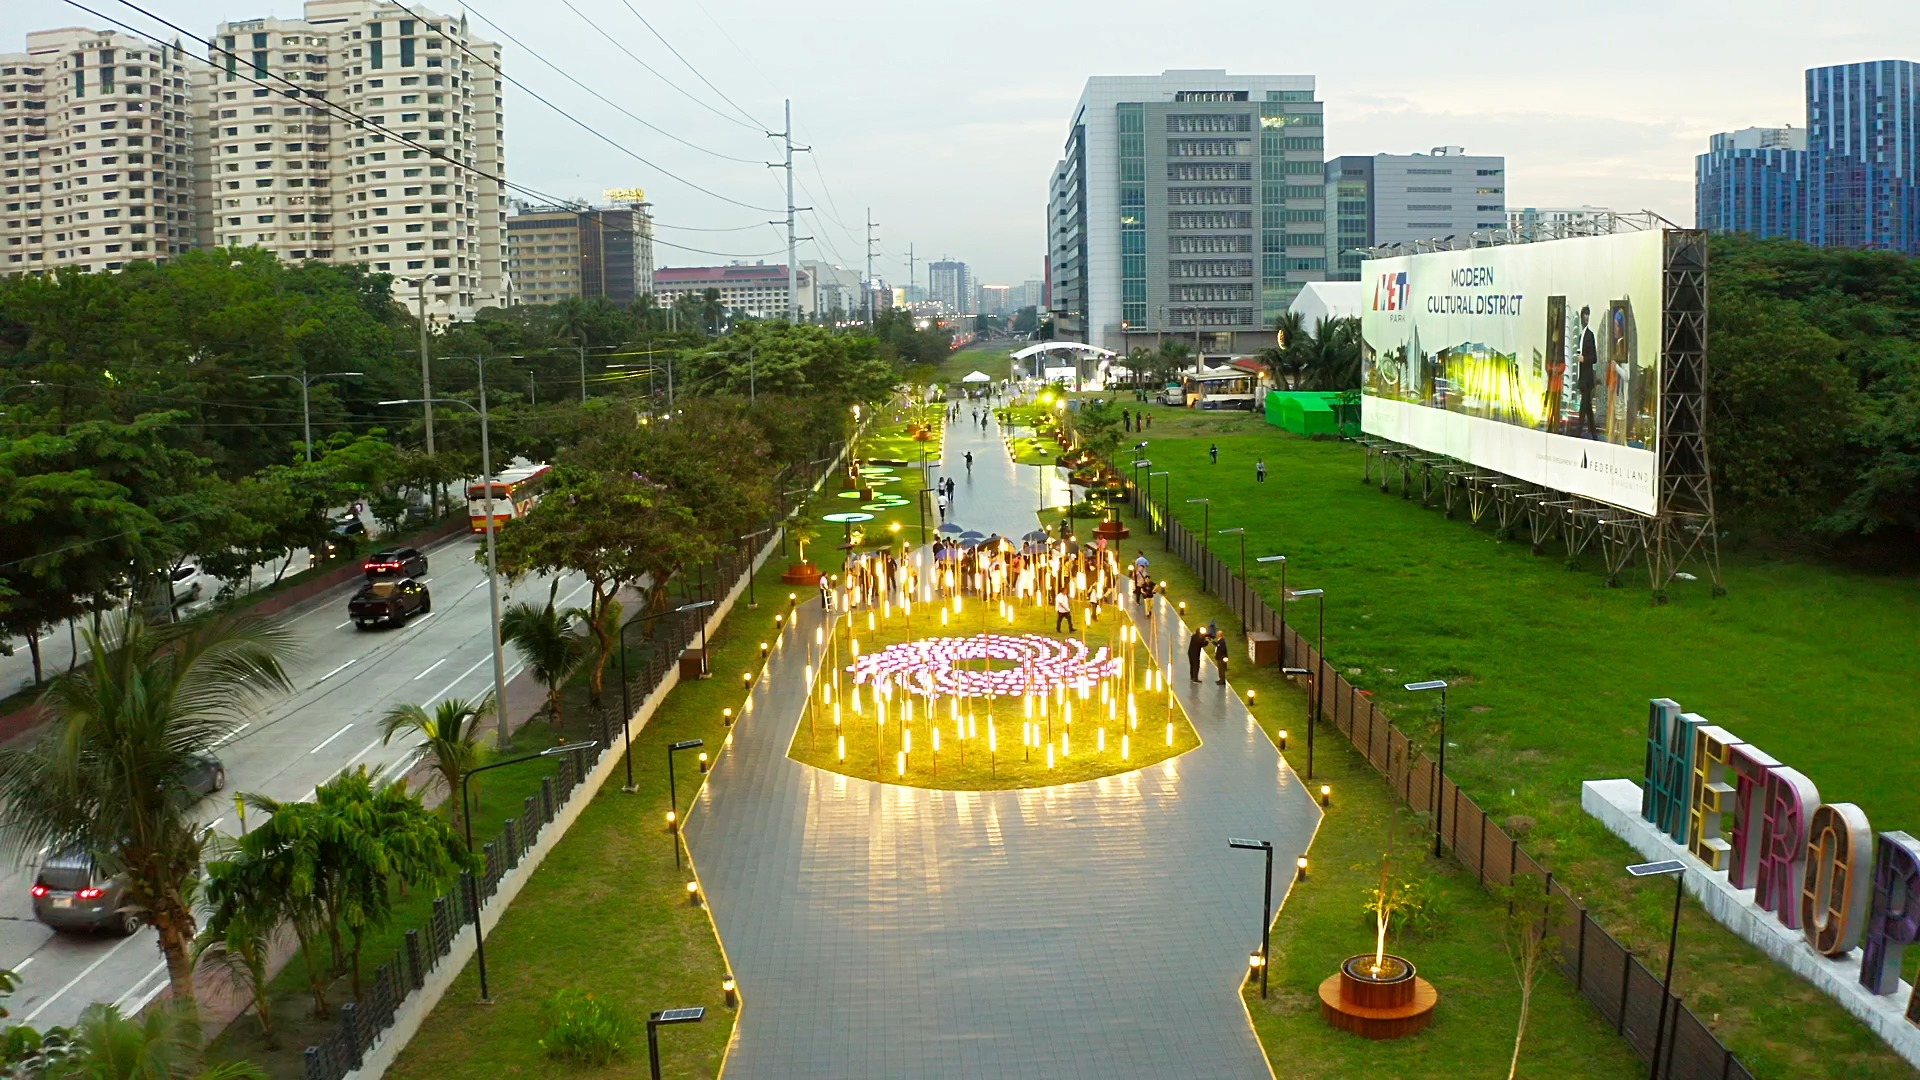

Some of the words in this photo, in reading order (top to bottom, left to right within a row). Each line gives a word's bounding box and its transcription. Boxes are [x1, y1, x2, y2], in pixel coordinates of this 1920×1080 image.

[1451, 266, 1494, 287] MODERN
[1427, 295, 1474, 314] CULTURAL
[1476, 294, 1523, 316] DISTRICT
[1589, 460, 1623, 477] FEDERAL
[1627, 468, 1648, 483] LAND
[1641, 697, 1920, 1029] METROP
